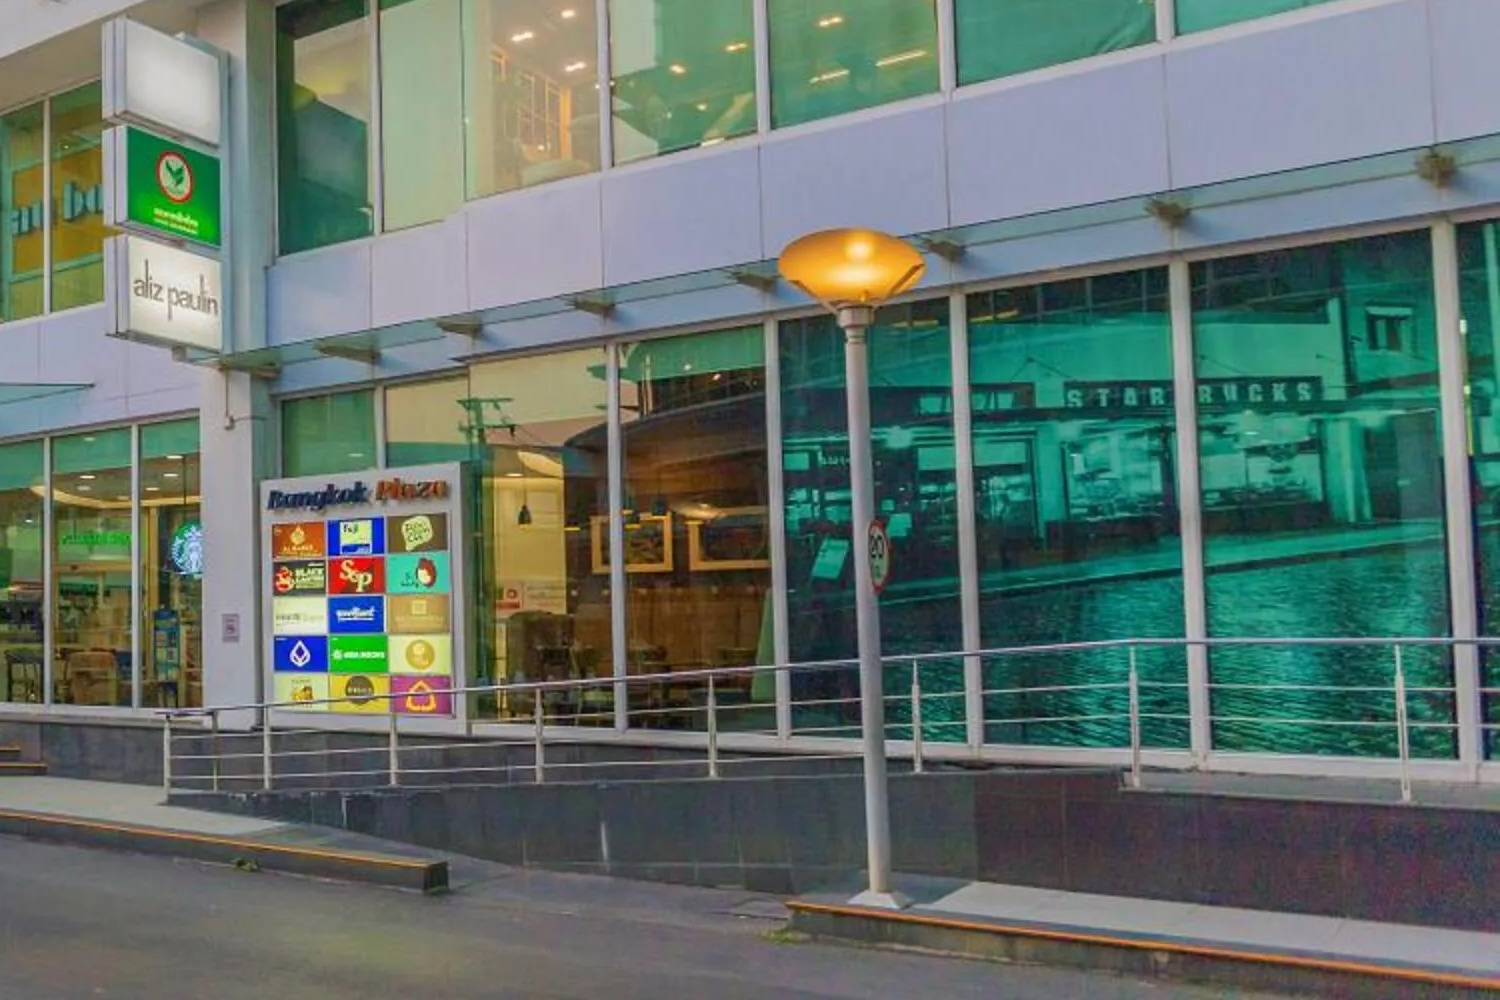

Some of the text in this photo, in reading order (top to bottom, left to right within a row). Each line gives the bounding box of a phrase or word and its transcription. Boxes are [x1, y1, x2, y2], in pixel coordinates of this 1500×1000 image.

[133, 257, 218, 322] aliz paulin
[1067, 382, 1312, 408] STARBUCKS
[268, 481, 368, 511] Bangkok
